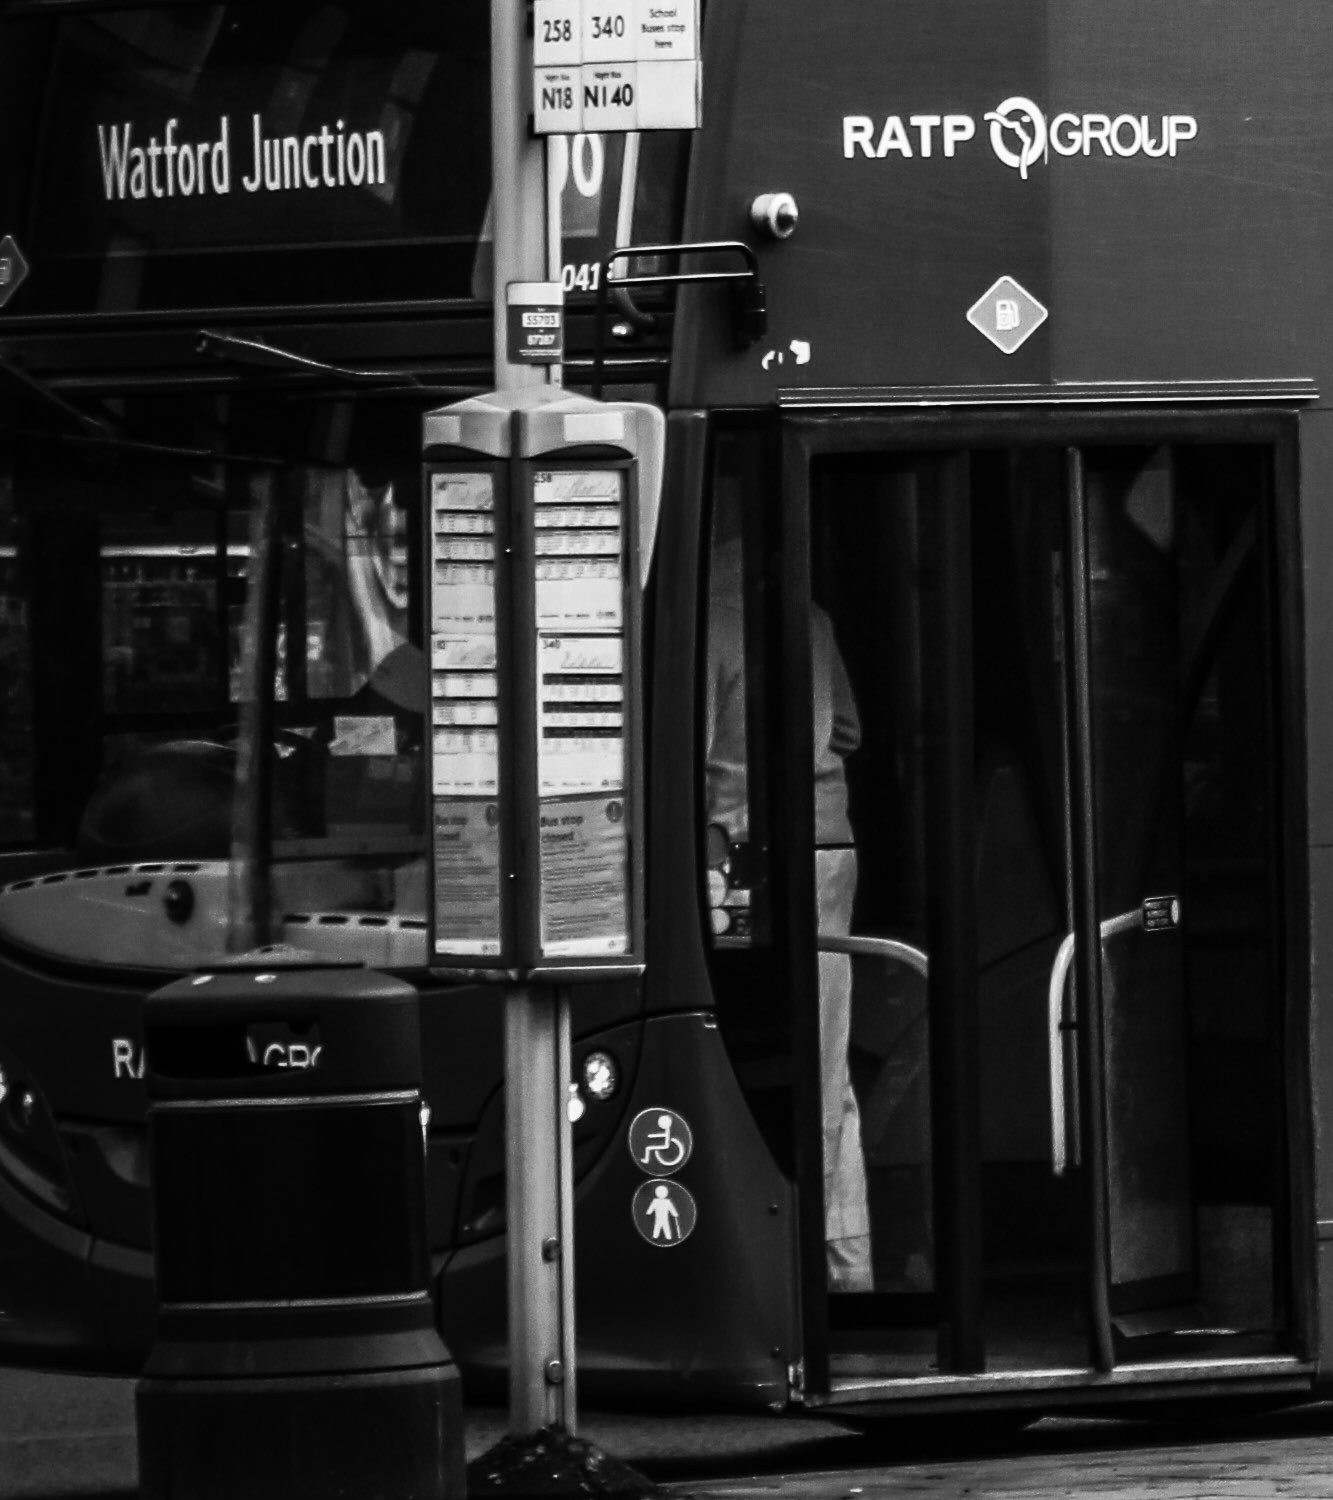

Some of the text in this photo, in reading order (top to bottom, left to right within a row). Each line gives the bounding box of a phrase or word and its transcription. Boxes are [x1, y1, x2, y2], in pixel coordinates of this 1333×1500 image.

[649, 8, 677, 18] School
[543, 15, 625, 43] 258 340
[641, 24, 686, 33] Buses stop
[542, 83, 634, 111] N18 N140
[843, 112, 1198, 159] RATP GROUP
[97, 113, 386, 201] Watford Junction
